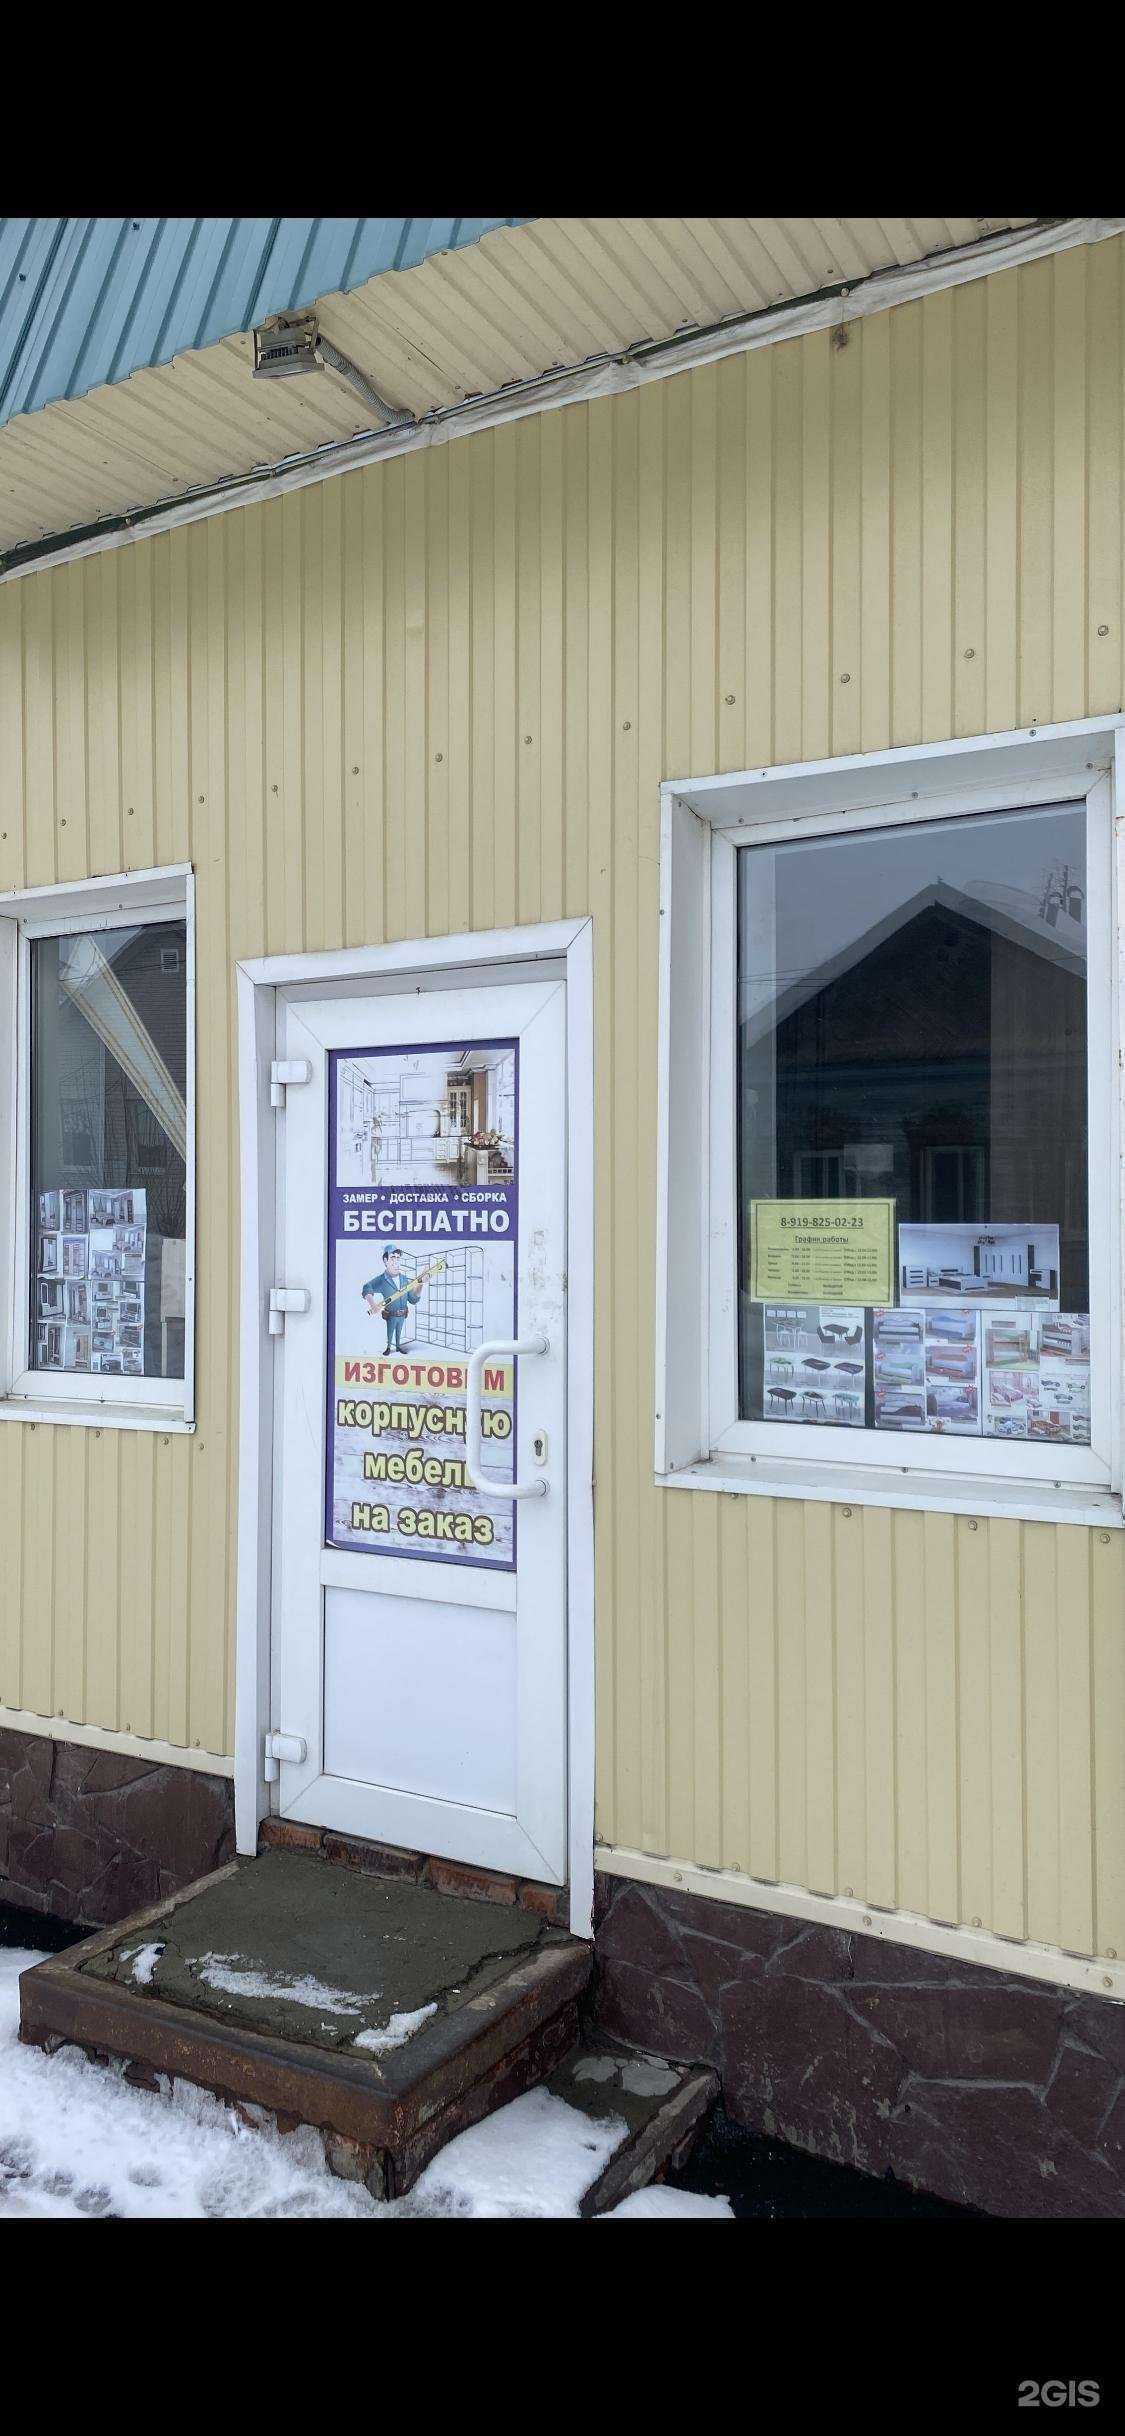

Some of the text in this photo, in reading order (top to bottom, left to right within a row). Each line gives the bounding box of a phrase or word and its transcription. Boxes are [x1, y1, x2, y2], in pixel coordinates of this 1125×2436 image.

[342, 1192, 507, 1205] ЗАМЕР ДОСТАВКА СБОРКА
[343, 1209, 510, 1233] БЕСПЛАТНО
[780, 1217, 864, 1229] 8-919-825-02-23
[822, 1235, 849, 1244] работы
[344, 1361, 505, 1391] ИЗГОТОВМ
[336, 1399, 512, 1440] корпусню
[351, 1501, 494, 1546] на заказ
